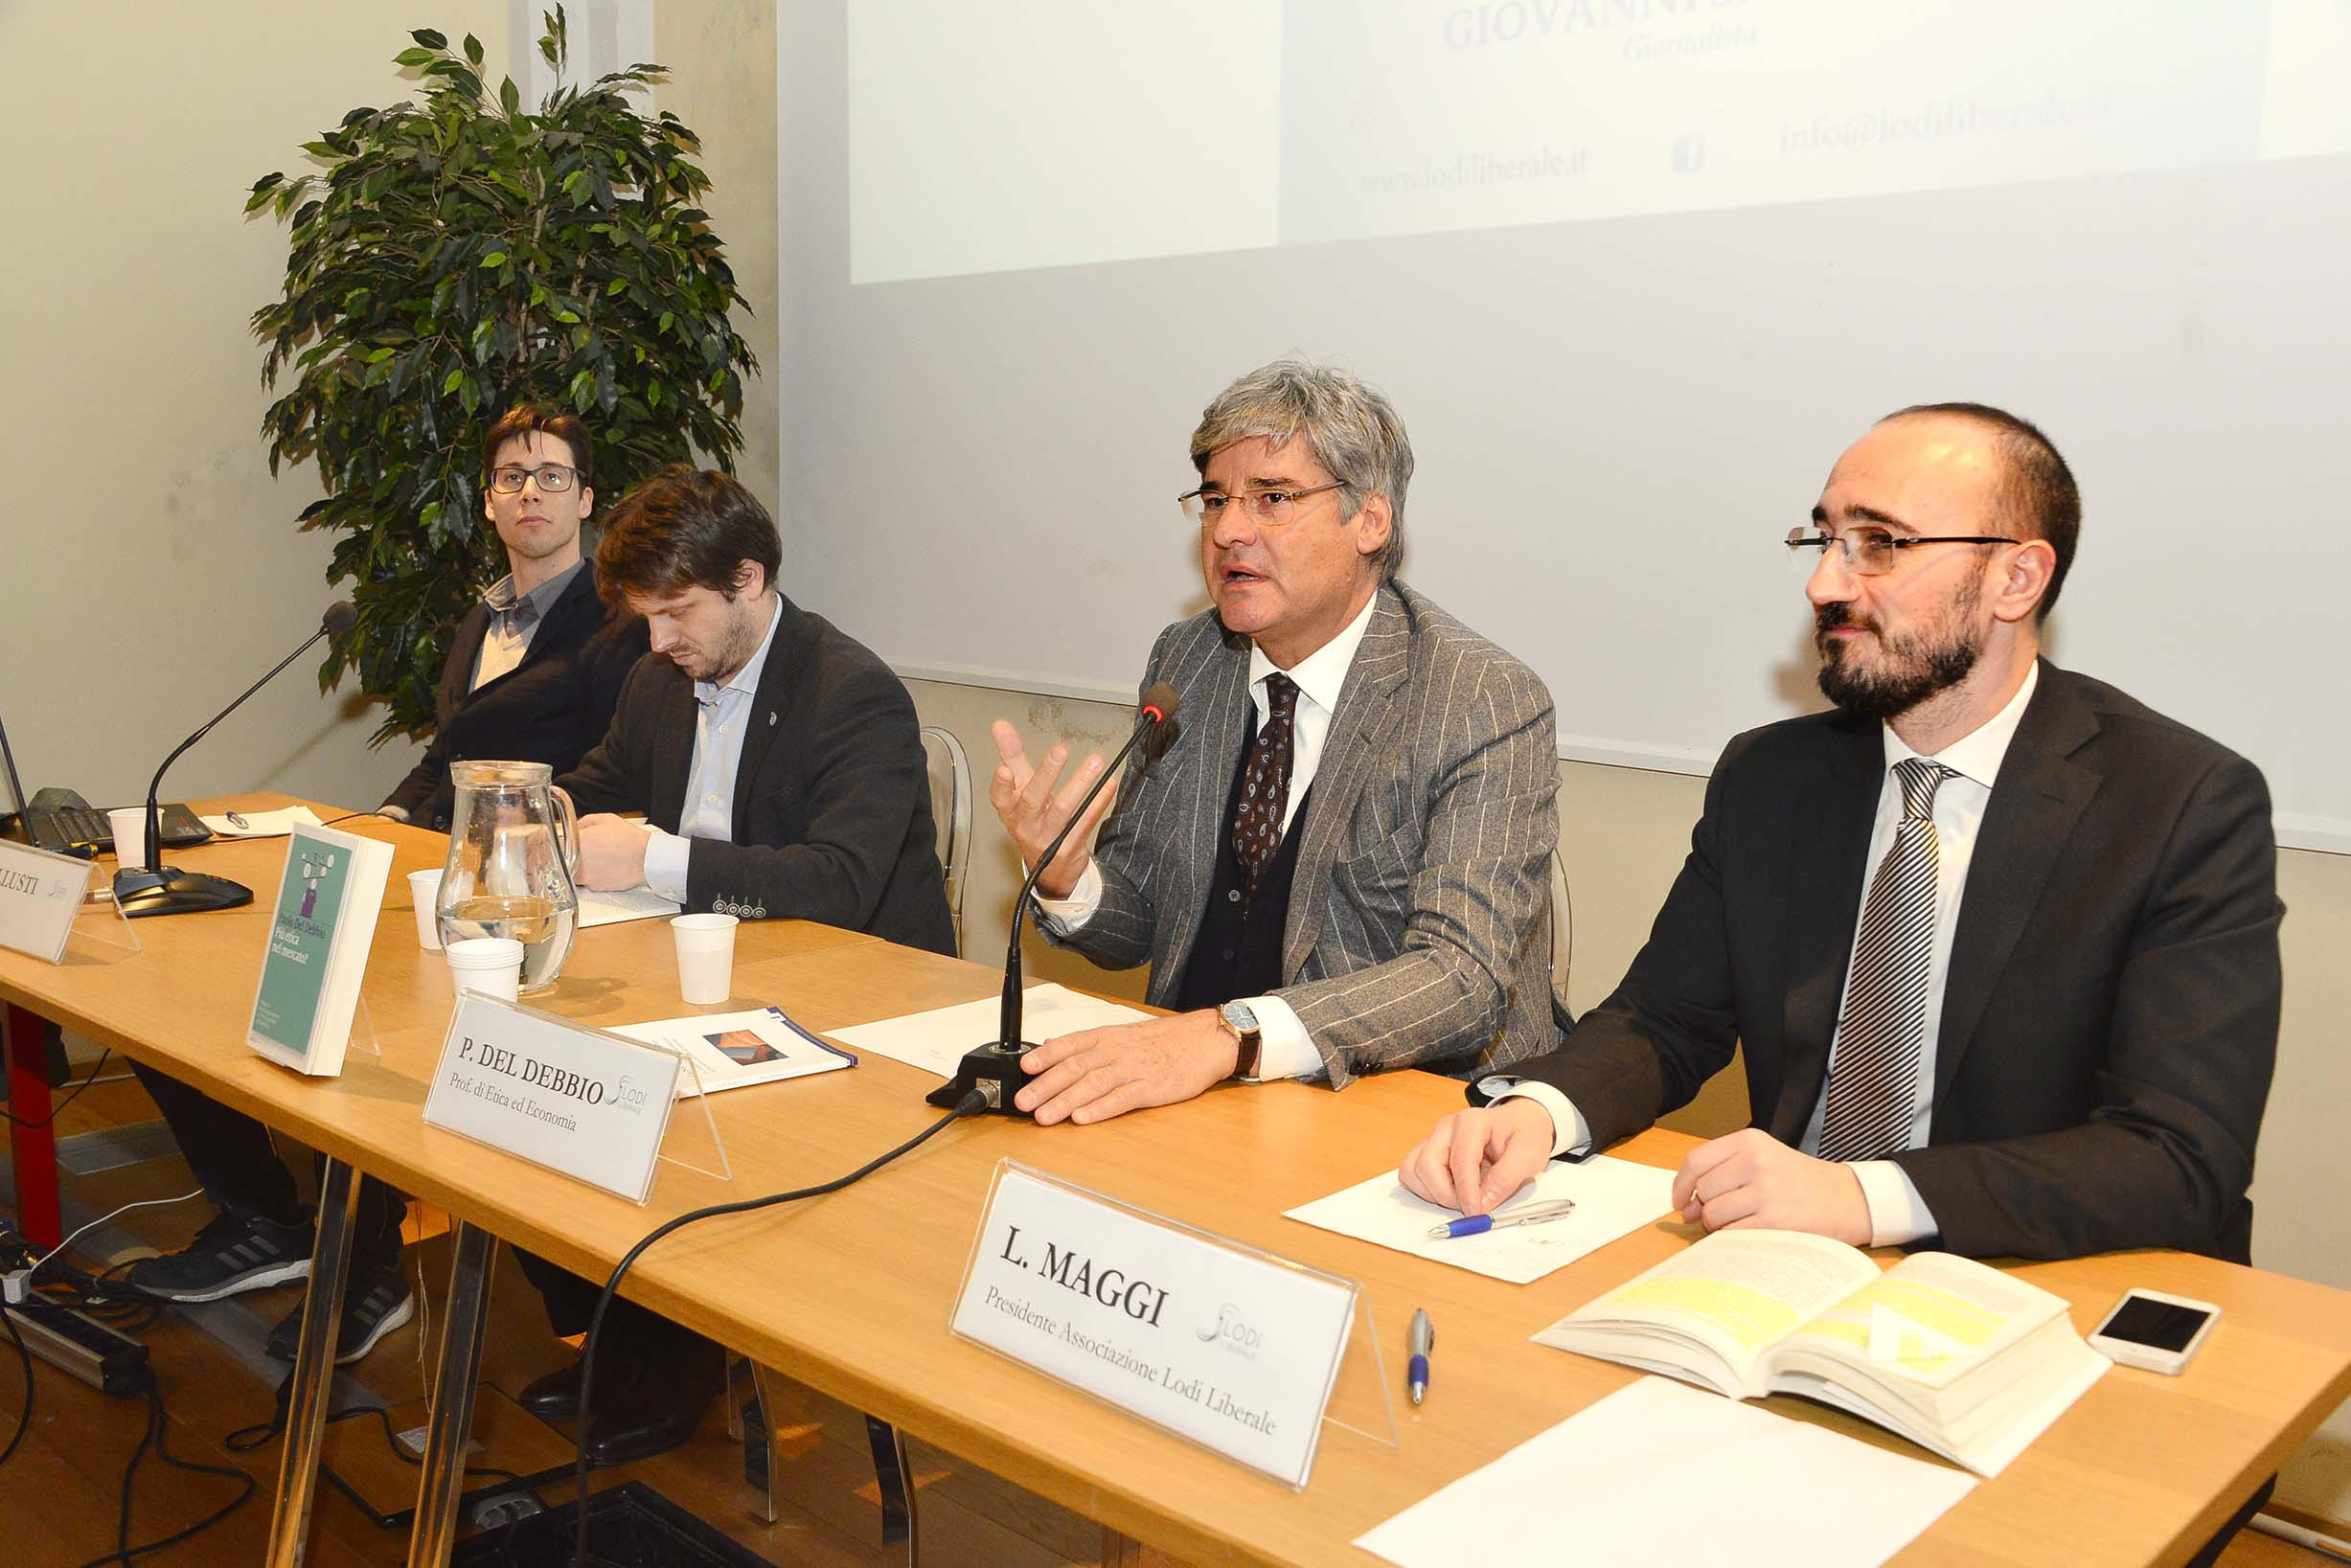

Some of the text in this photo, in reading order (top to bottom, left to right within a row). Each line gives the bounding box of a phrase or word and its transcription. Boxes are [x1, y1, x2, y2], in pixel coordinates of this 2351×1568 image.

[1441, 0, 1696, 51] GIOVAN
[1621, 21, 1760, 65] Giornalista
[449, 1072, 578, 1132] Prof. di Etica ed Economia
[458, 1037, 605, 1105] P. DEL DEBBIO
[1000, 1225, 1170, 1328] L. MAGGI
[985, 1285, 1276, 1437] Presidente Associazione Lodi Liberale
